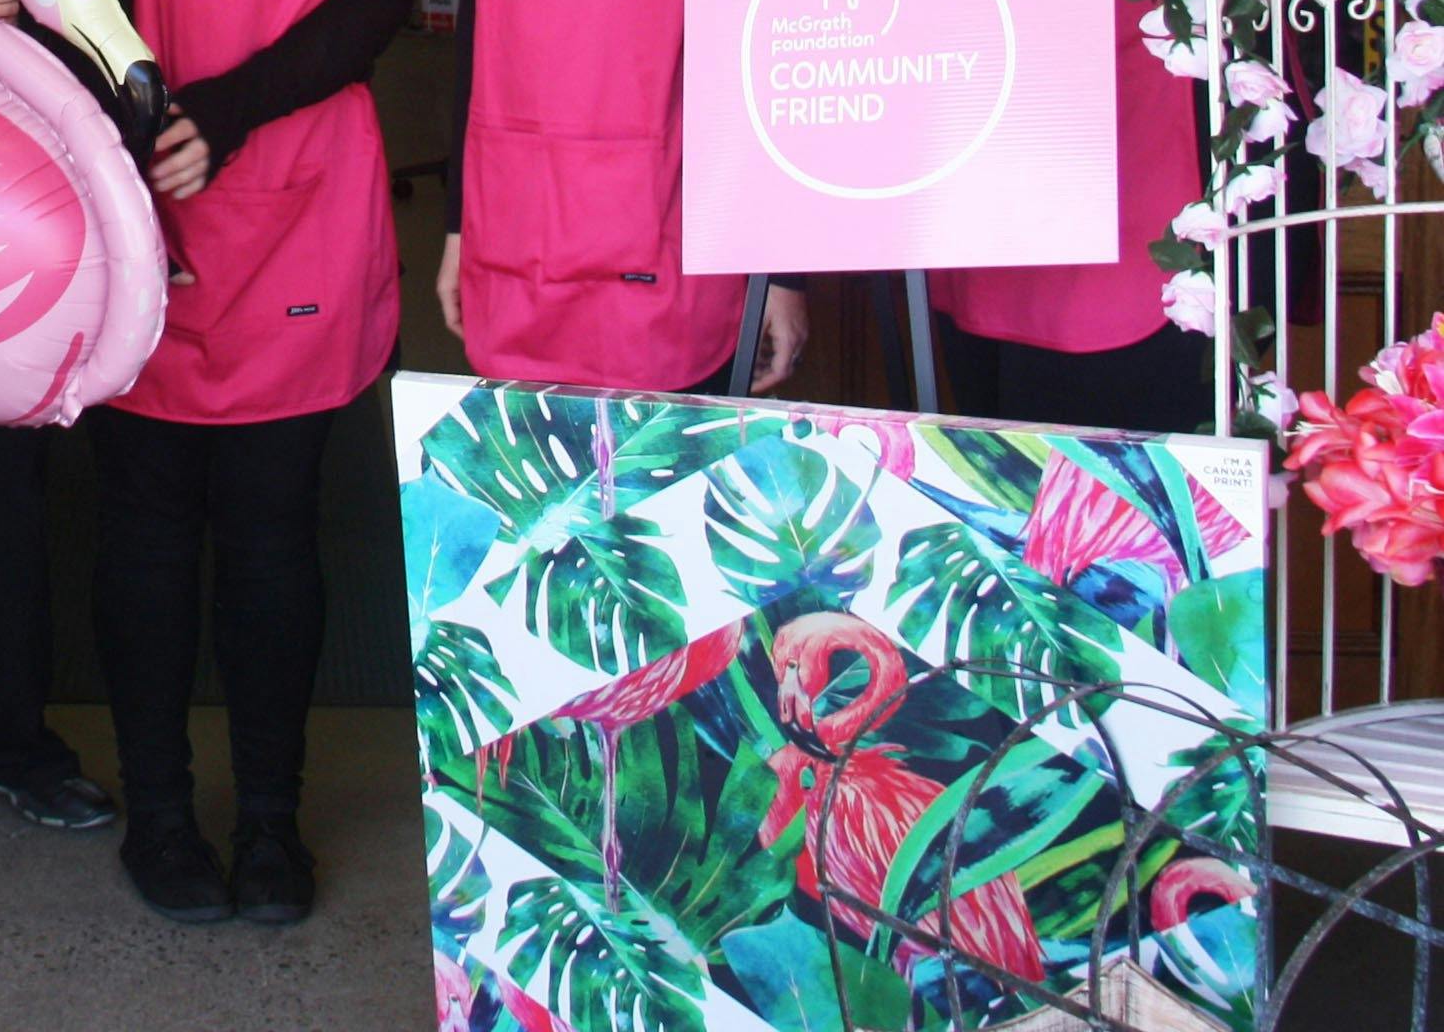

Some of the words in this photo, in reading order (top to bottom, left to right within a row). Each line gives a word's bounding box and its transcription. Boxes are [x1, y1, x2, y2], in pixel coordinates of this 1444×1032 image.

[770, 12, 853, 35] McGrath
[770, 32, 876, 57] Foundation
[769, 51, 980, 91] COMMUNITY
[769, 93, 886, 127] FRIEND
[1202, 465, 1253, 478] CANVAS
[1244, 458, 1253, 467] A
